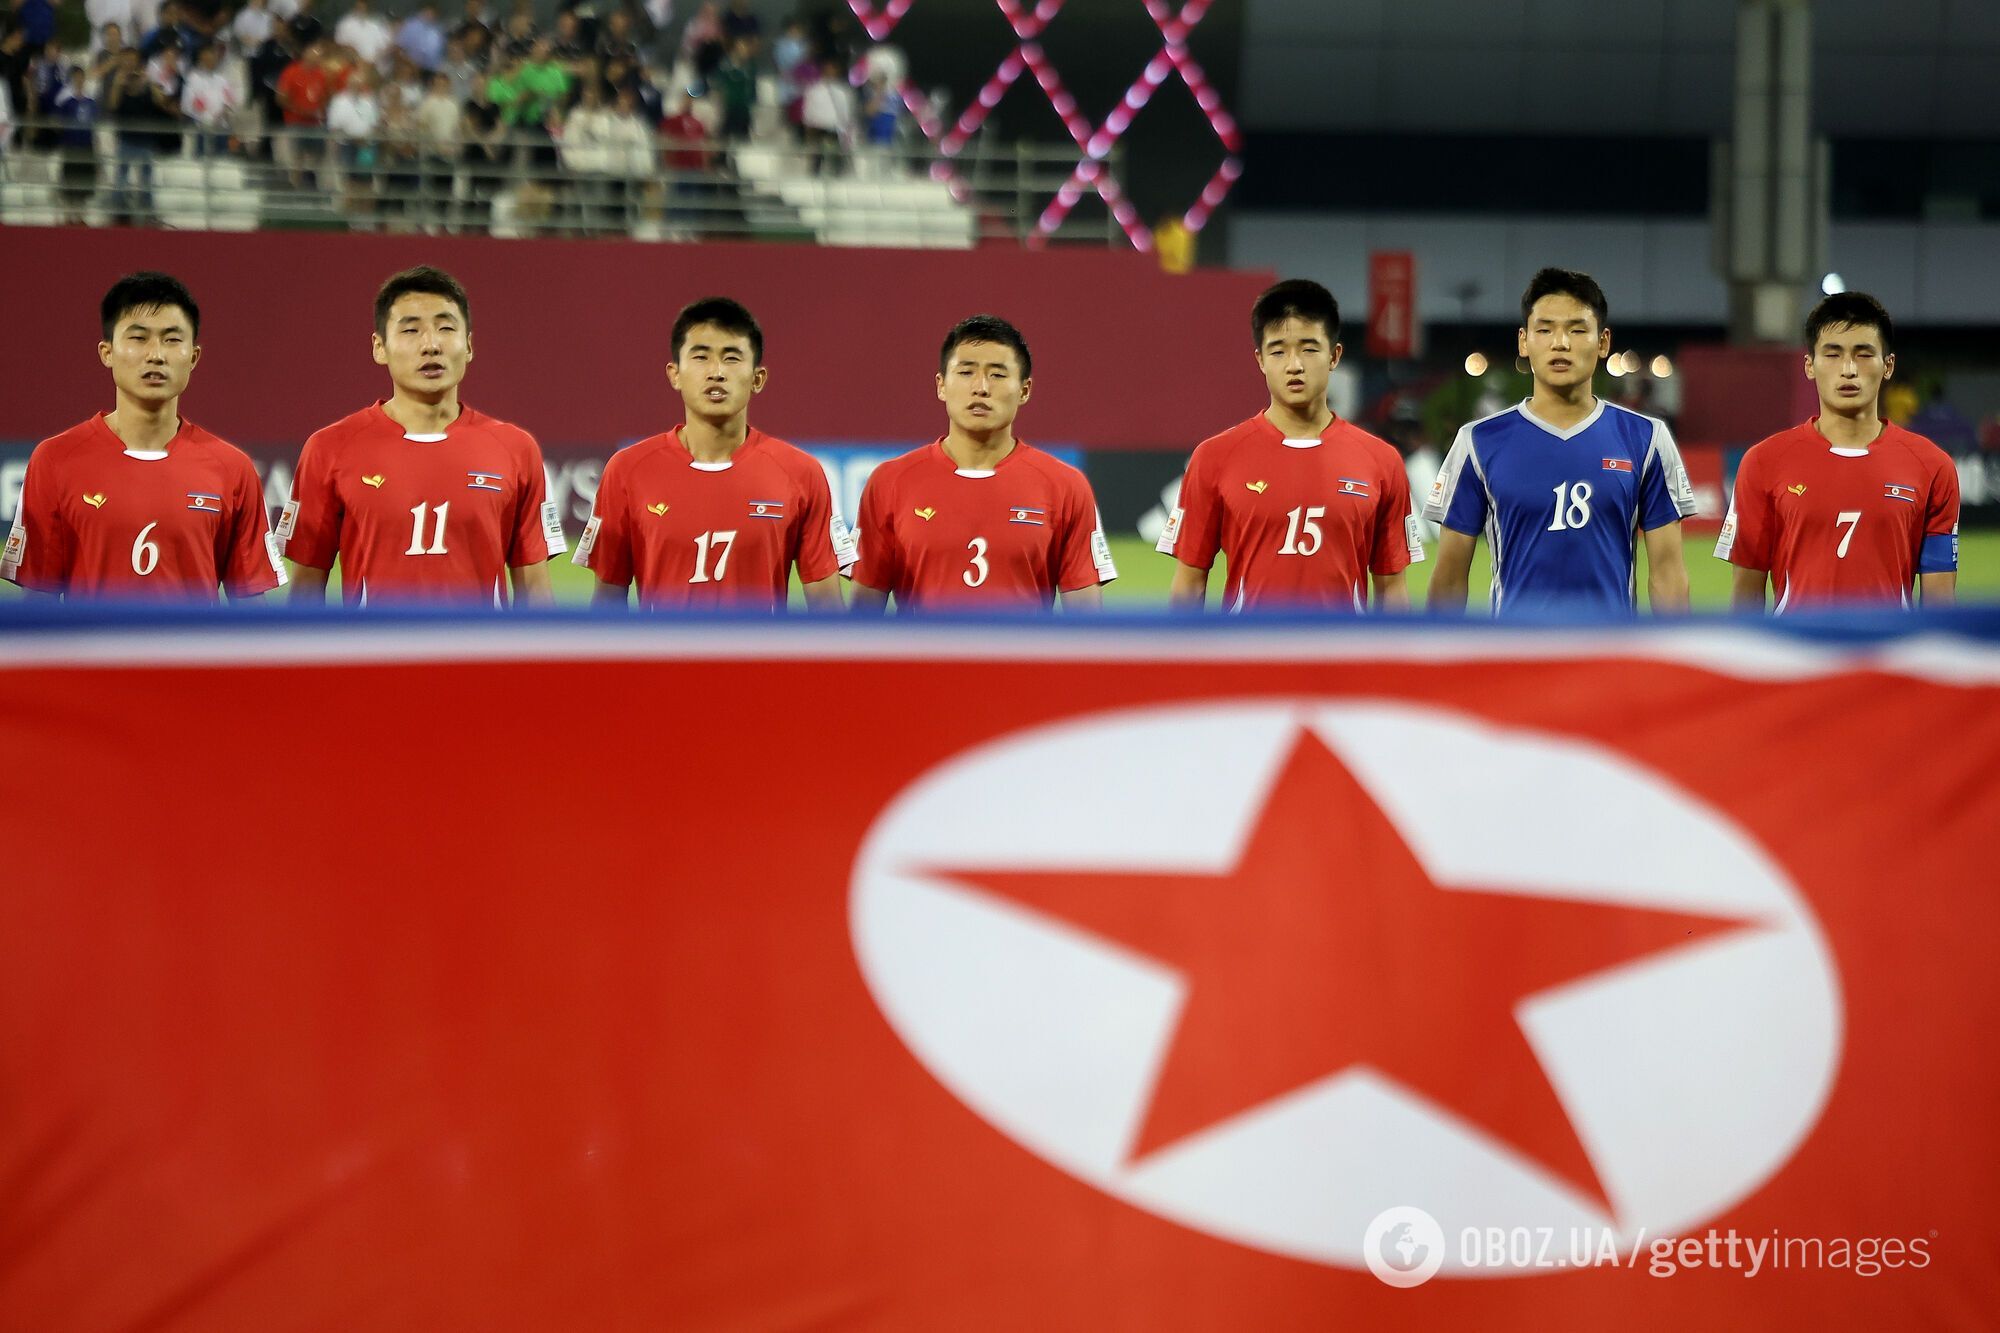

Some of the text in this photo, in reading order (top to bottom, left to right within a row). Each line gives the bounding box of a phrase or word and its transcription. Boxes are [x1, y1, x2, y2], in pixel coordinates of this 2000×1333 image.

[405, 501, 449, 556] 11
[1278, 507, 1326, 556] 15
[1548, 482, 1592, 531] 18
[132, 523, 158, 576] 6
[689, 531, 737, 583] 17
[1836, 512, 1862, 559] 7
[962, 537, 988, 588] 3
